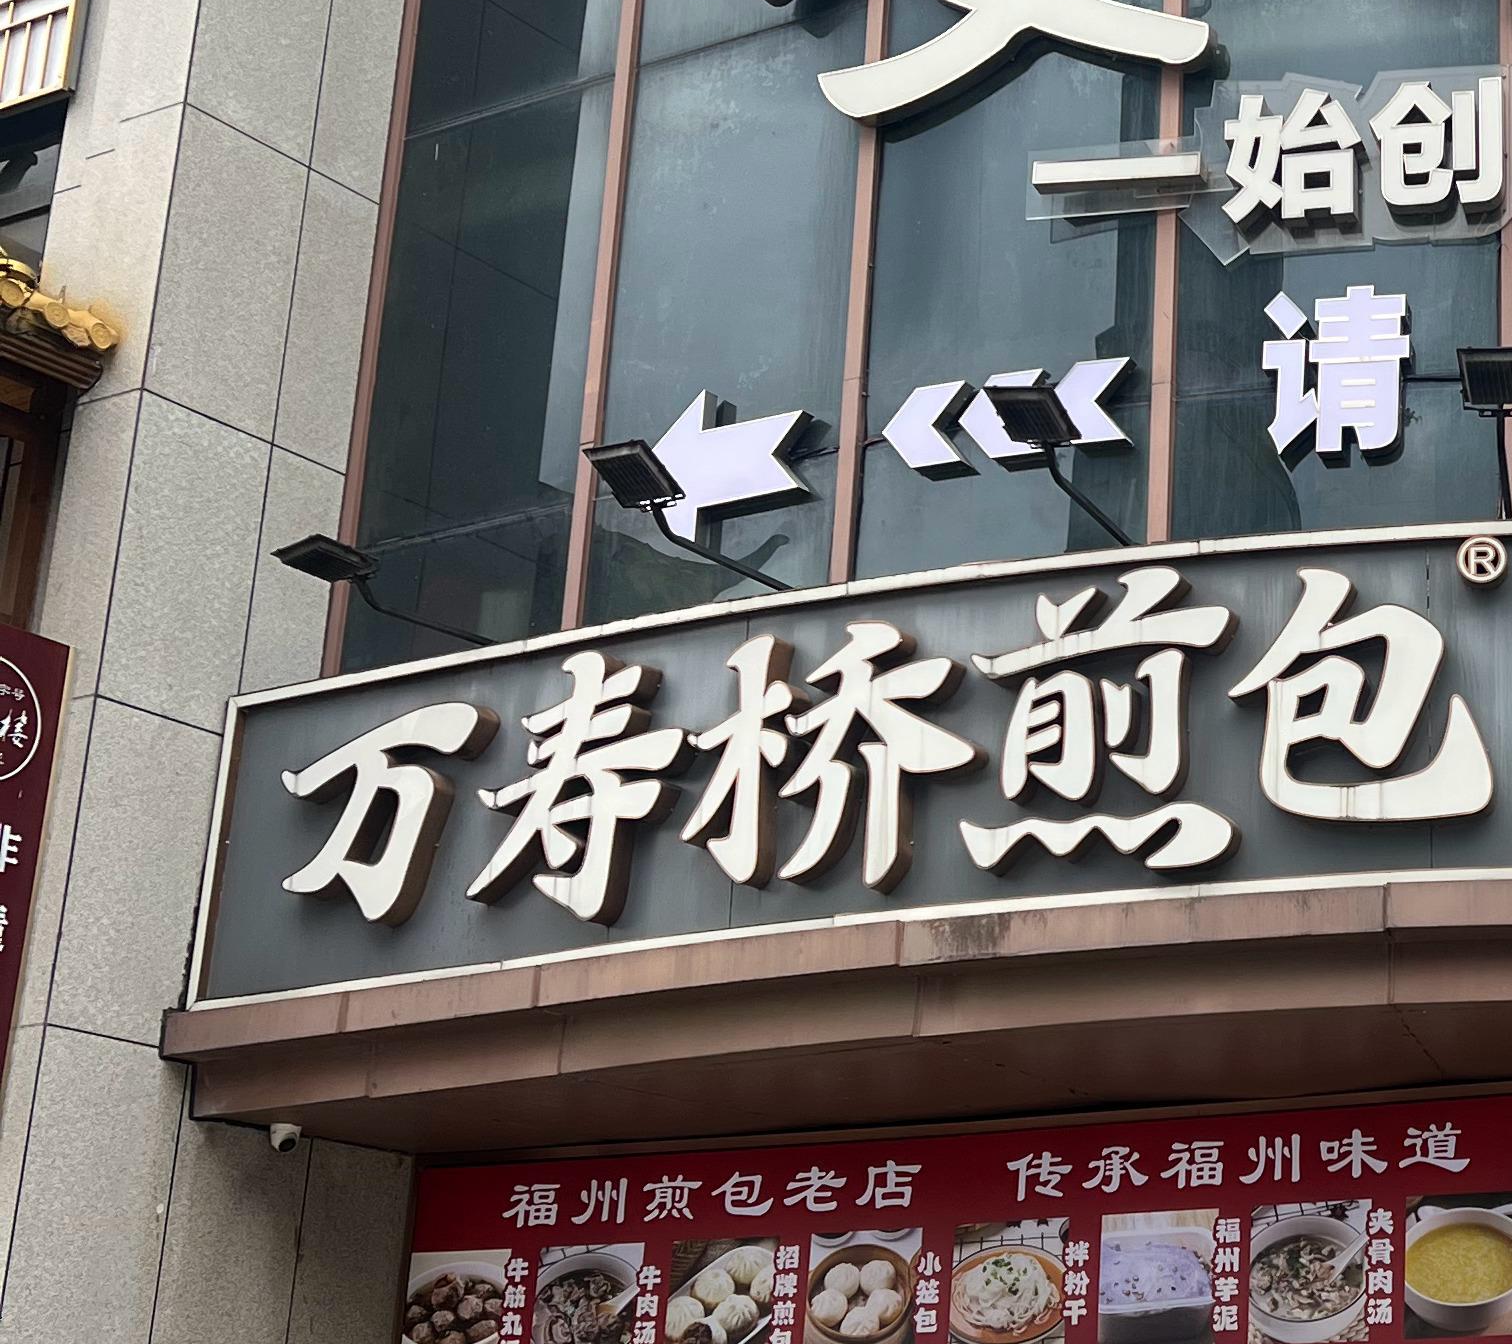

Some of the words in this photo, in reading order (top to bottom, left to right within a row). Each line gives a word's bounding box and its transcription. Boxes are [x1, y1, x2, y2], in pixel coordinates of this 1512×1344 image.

[281, 564, 1497, 924] 万寿桥煎包
[502, 1159, 921, 1228] 福州煎包老店
[1007, 1121, 1470, 1202] 传承福州味道
[913, 1251, 942, 1334] 小笼包
[1063, 1240, 1090, 1326] 拌粉干
[1213, 1217, 1242, 1333] 福州芋泥
[1366, 1208, 1395, 1326] 夹骨肉汤
